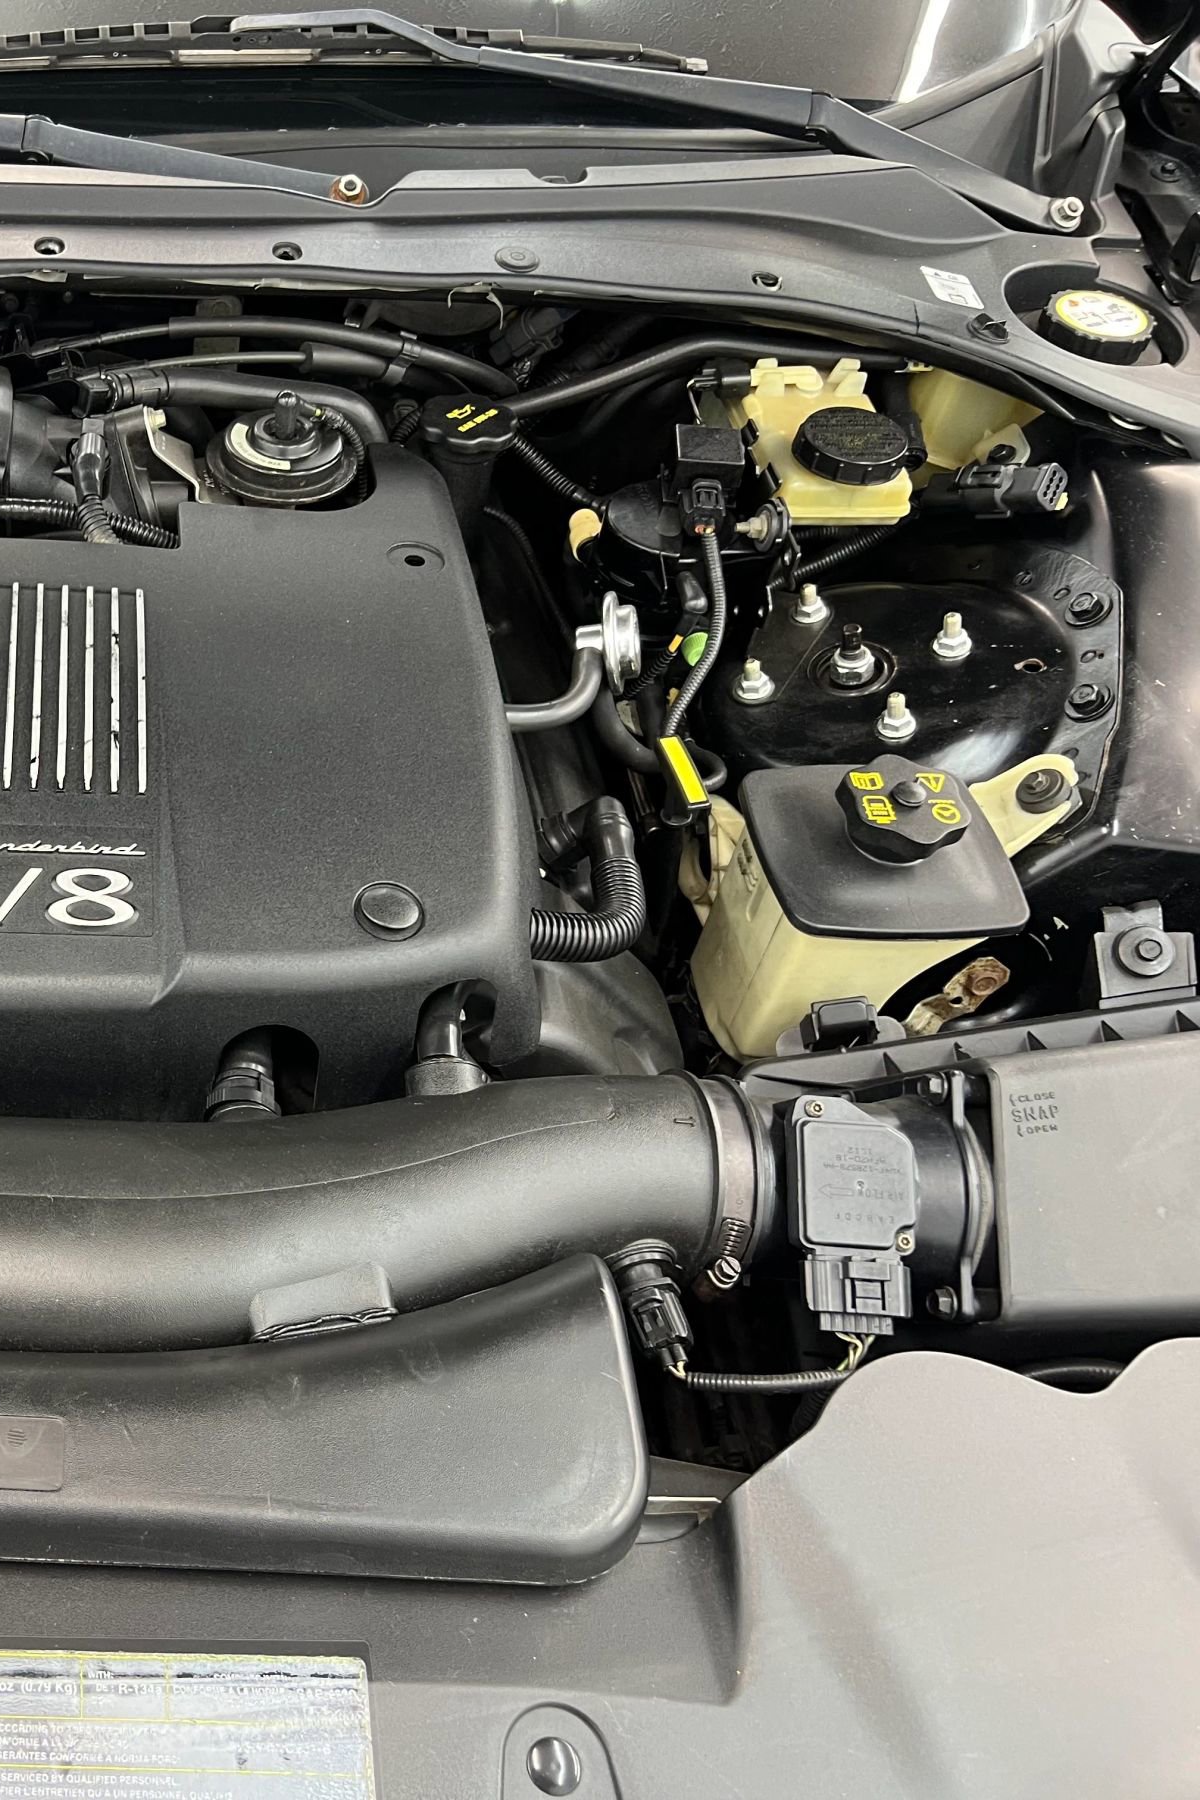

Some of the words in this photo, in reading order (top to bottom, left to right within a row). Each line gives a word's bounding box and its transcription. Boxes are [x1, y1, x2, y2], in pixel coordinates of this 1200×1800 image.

[1018, 1091, 1055, 1103] CLOSE
[1011, 1105, 1059, 1122] SNAP
[56, 1682, 77, 1695] Kg)
[0, 1773, 49, 1783] SERVICED
[66, 1774, 117, 1784] QUALIFIED
